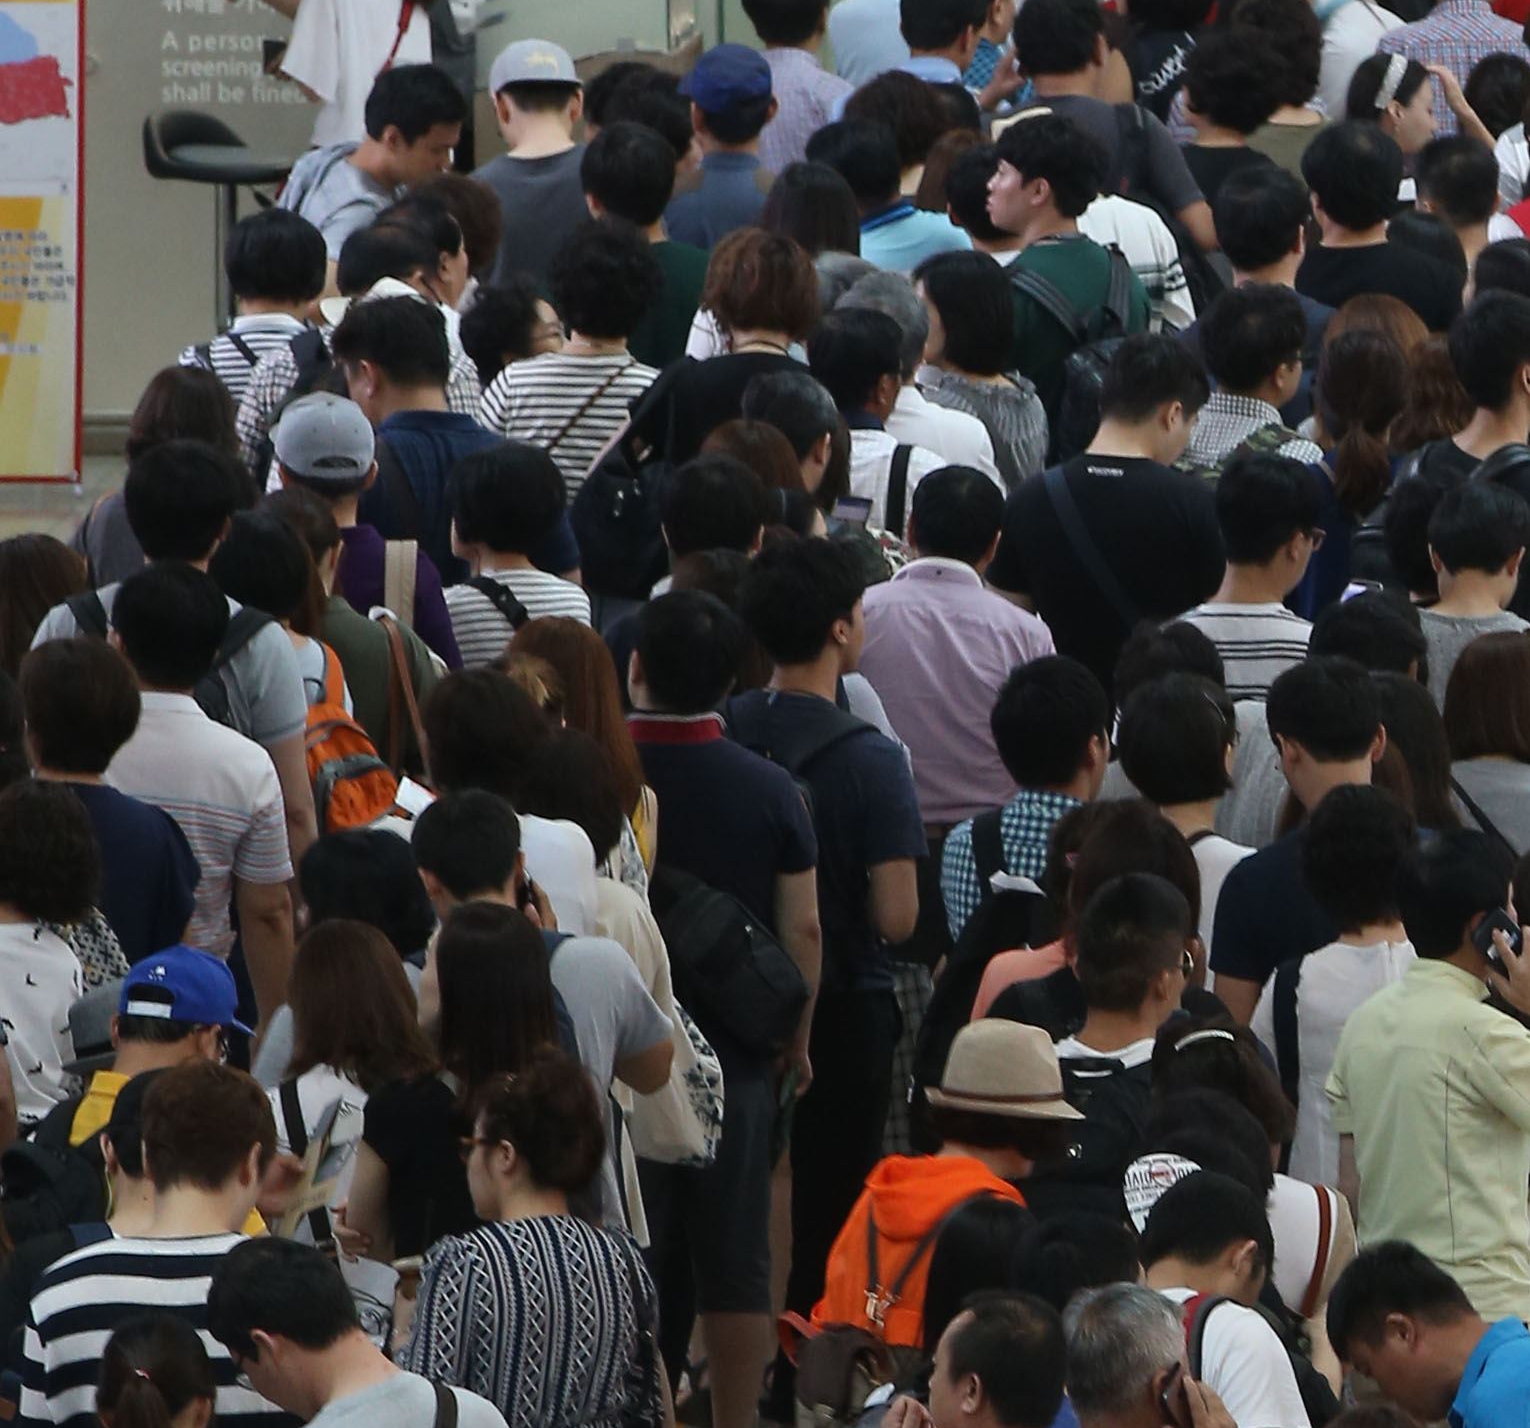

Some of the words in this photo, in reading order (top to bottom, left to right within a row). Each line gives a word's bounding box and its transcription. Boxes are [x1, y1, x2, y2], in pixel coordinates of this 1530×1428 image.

[161, 30, 178, 51] A
[161, 82, 212, 105] shall
[218, 82, 247, 105] be
